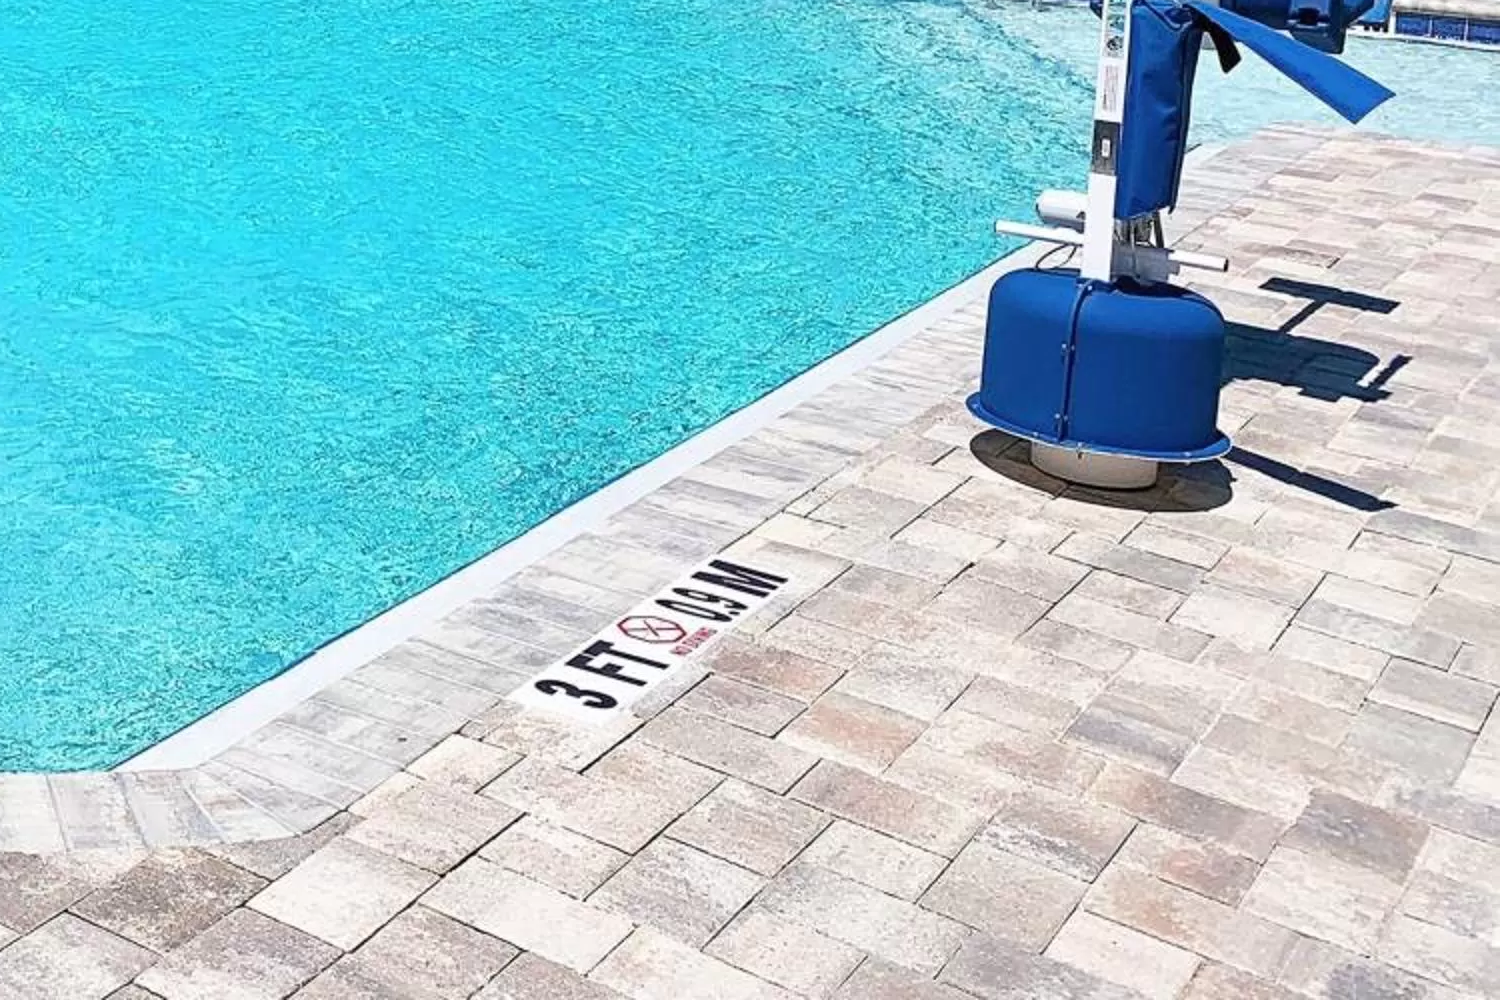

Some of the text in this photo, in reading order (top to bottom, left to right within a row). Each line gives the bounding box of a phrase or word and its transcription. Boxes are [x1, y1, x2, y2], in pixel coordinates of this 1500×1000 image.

[690, 558, 789, 599] M
[564, 639, 670, 687] FT
[534, 678, 618, 709] 3
